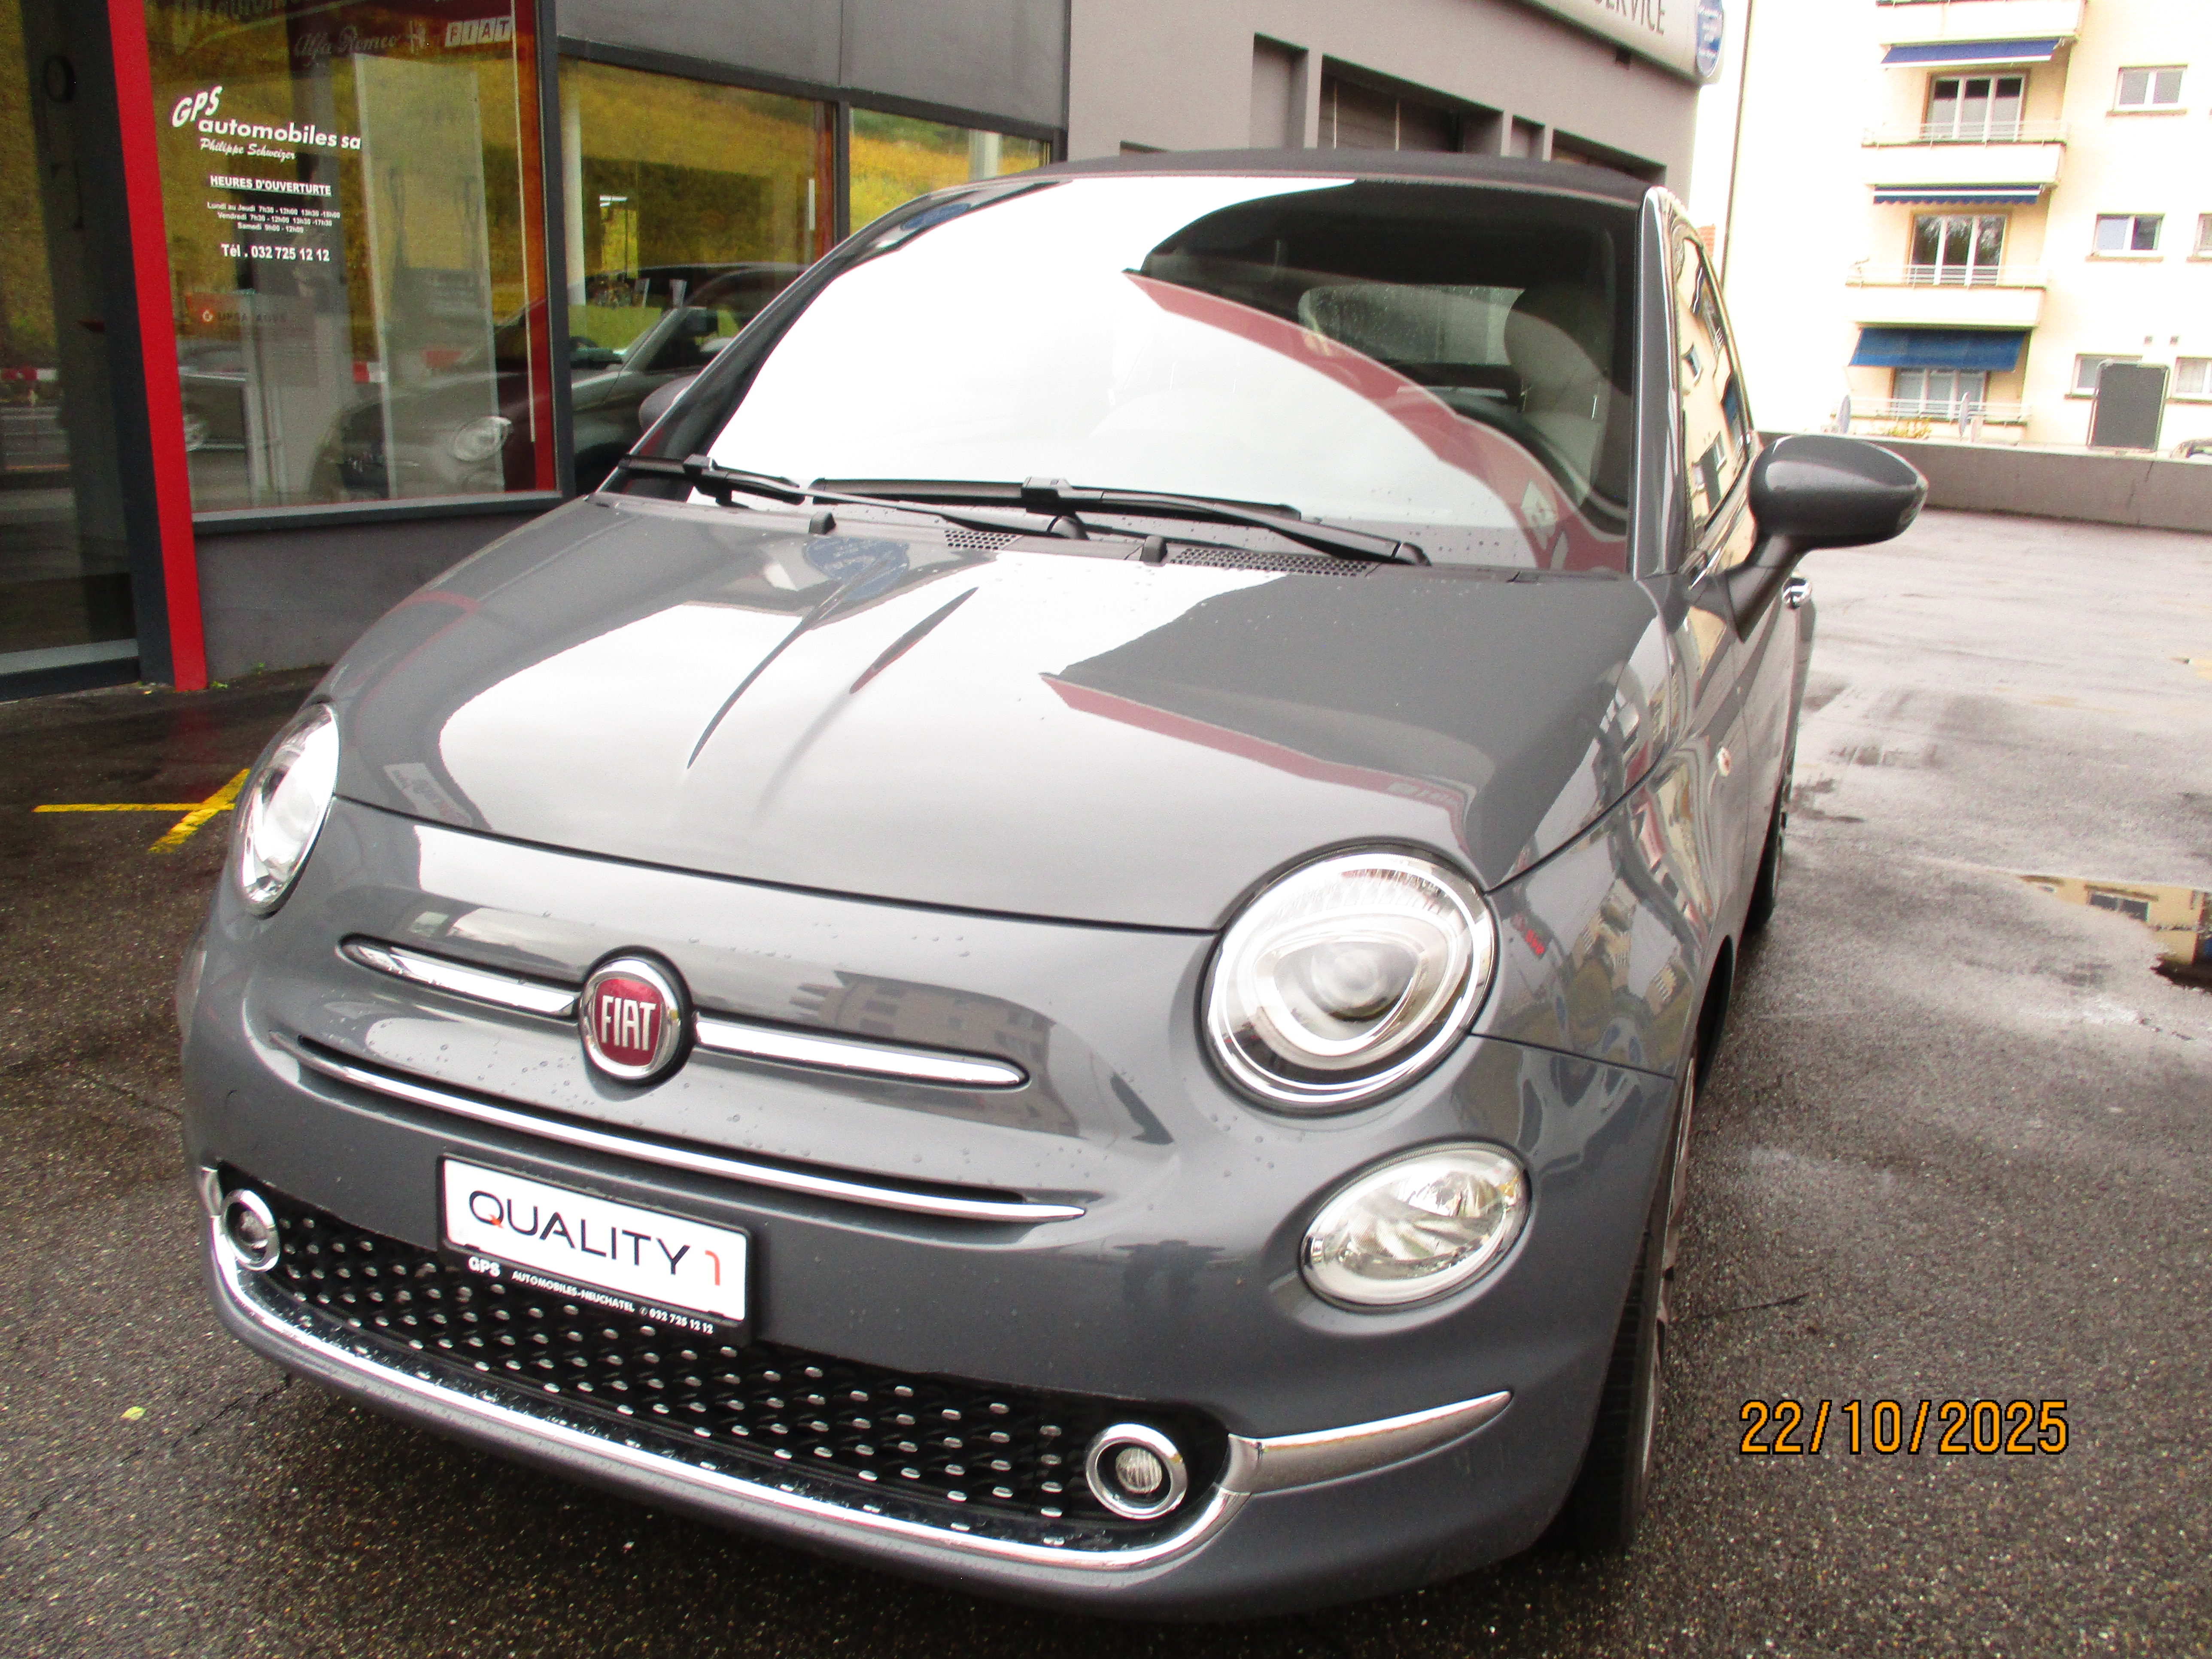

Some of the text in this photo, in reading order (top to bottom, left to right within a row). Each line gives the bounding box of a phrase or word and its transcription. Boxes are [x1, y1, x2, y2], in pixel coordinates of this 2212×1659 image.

[449, 19, 510, 43] FIAT
[172, 85, 223, 128] GPS
[198, 118, 361, 149] automobiles sa
[200, 137, 295, 163] Philippe Schweizer
[210, 175, 331, 195] HEURES D'OUVERTURTE
[251, 245, 273, 259] 032
[275, 246, 296, 260] 725
[299, 248, 313, 261] 12
[316, 248, 330, 262] 12
[601, 994, 657, 1051] FIAT
[469, 1190, 690, 1276] QUALITY
[468, 1256, 501, 1277] GPS
[511, 1270, 635, 1313] AUTOMOBILES-NEUCHATEL
[668, 1313, 688, 1328] 725
[689, 1319, 701, 1331] 12
[702, 1322, 714, 1335] 12
